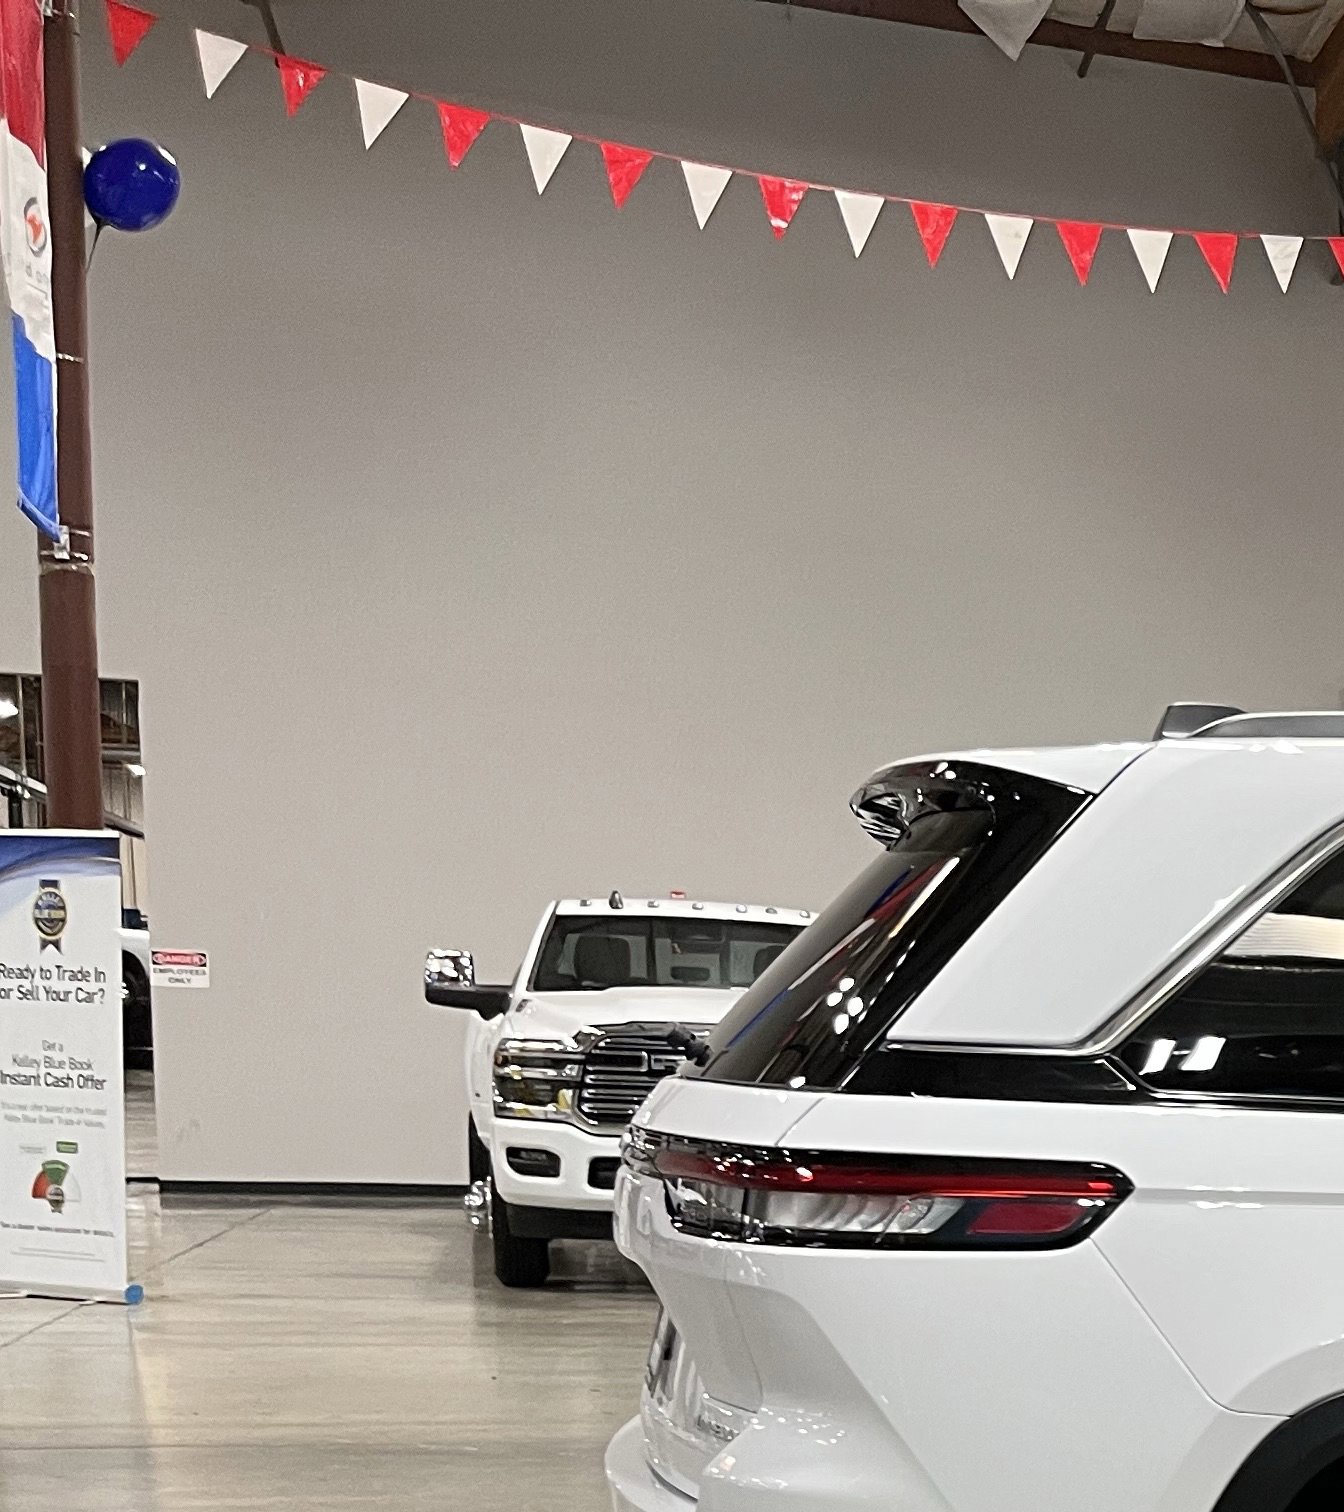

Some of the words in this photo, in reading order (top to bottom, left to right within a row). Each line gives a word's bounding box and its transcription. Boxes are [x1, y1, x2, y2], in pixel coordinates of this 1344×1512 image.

[0, 963, 36, 983] Ready
[40, 965, 52, 980] to
[55, 965, 92, 983] Trade
[94, 966, 106, 983] In
[0, 987, 14, 1000] or
[16, 984, 40, 1001] Sell
[42, 985, 73, 1002] Your
[75, 987, 105, 1004] Car?
[43, 1055, 66, 1070] Blue
[68, 1056, 94, 1071] Book
[0, 1070, 41, 1086] Instant
[44, 1072, 74, 1088] Cash
[77, 1073, 107, 1090] Offer
